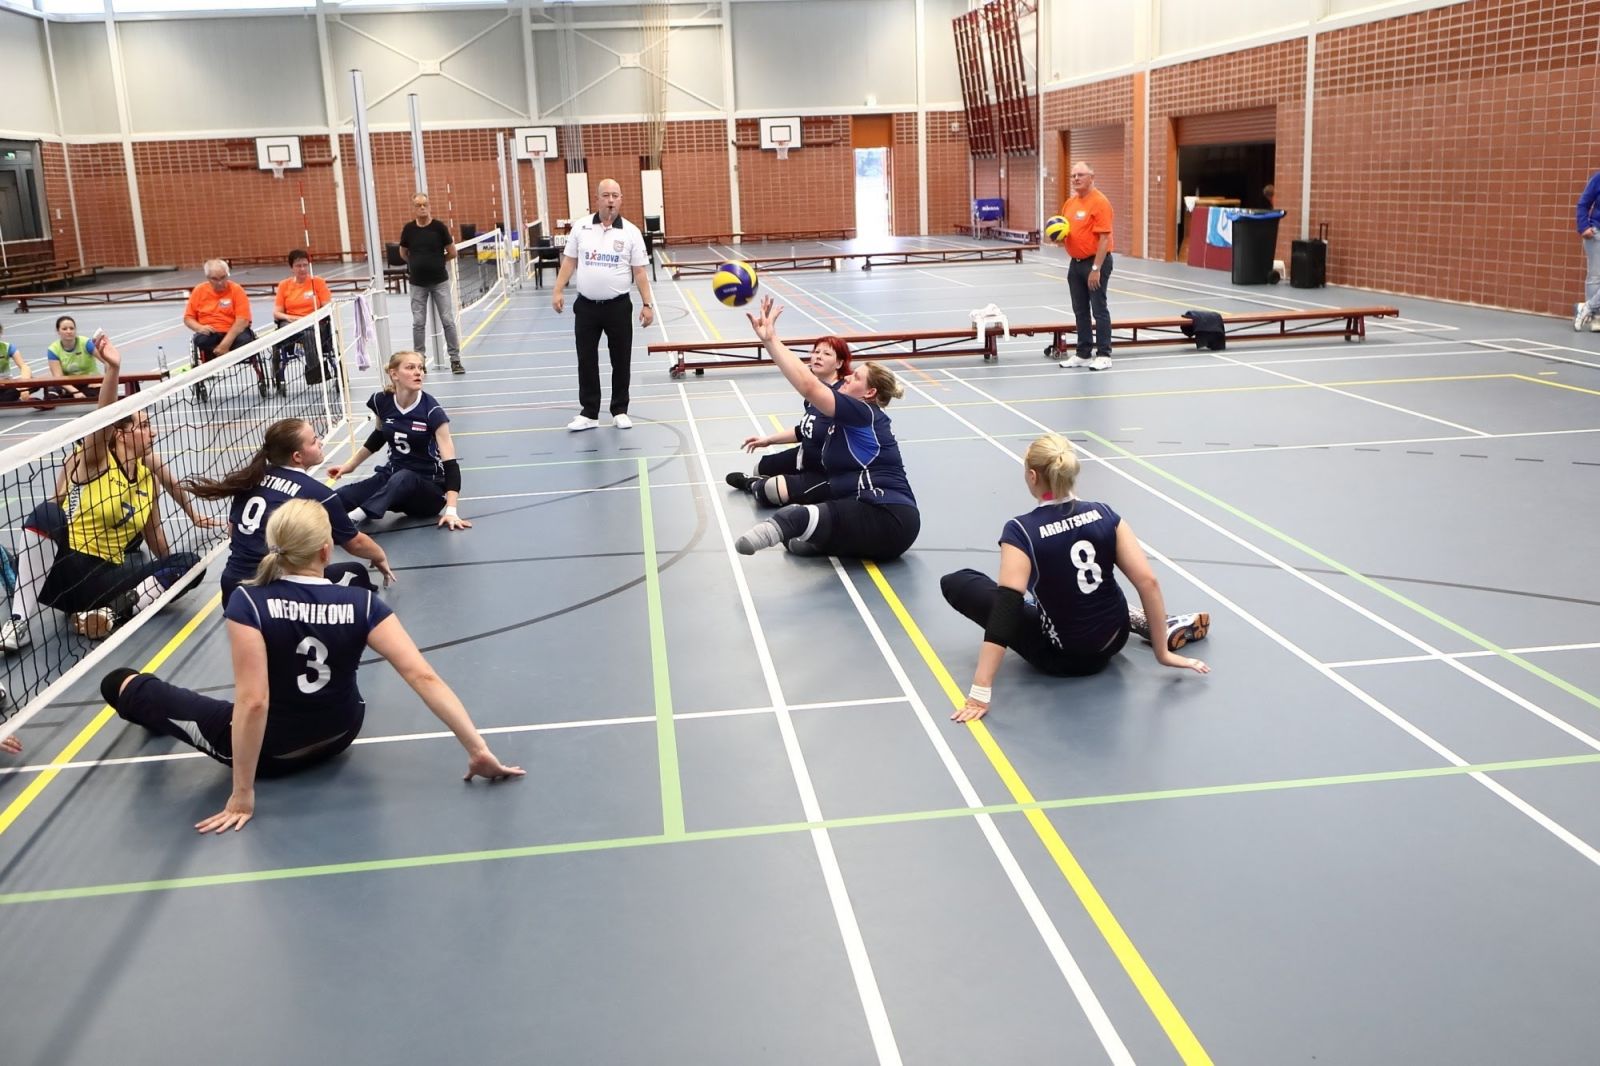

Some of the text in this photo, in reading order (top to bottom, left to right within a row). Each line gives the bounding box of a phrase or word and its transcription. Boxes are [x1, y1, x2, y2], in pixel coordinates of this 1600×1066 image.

[585, 249, 620, 263] axanova
[394, 431, 411, 454] 5
[237, 496, 267, 535] 9
[1070, 540, 1103, 594] 8
[266, 598, 355, 625] MEDNIKOVA
[295, 635, 332, 694] 3
